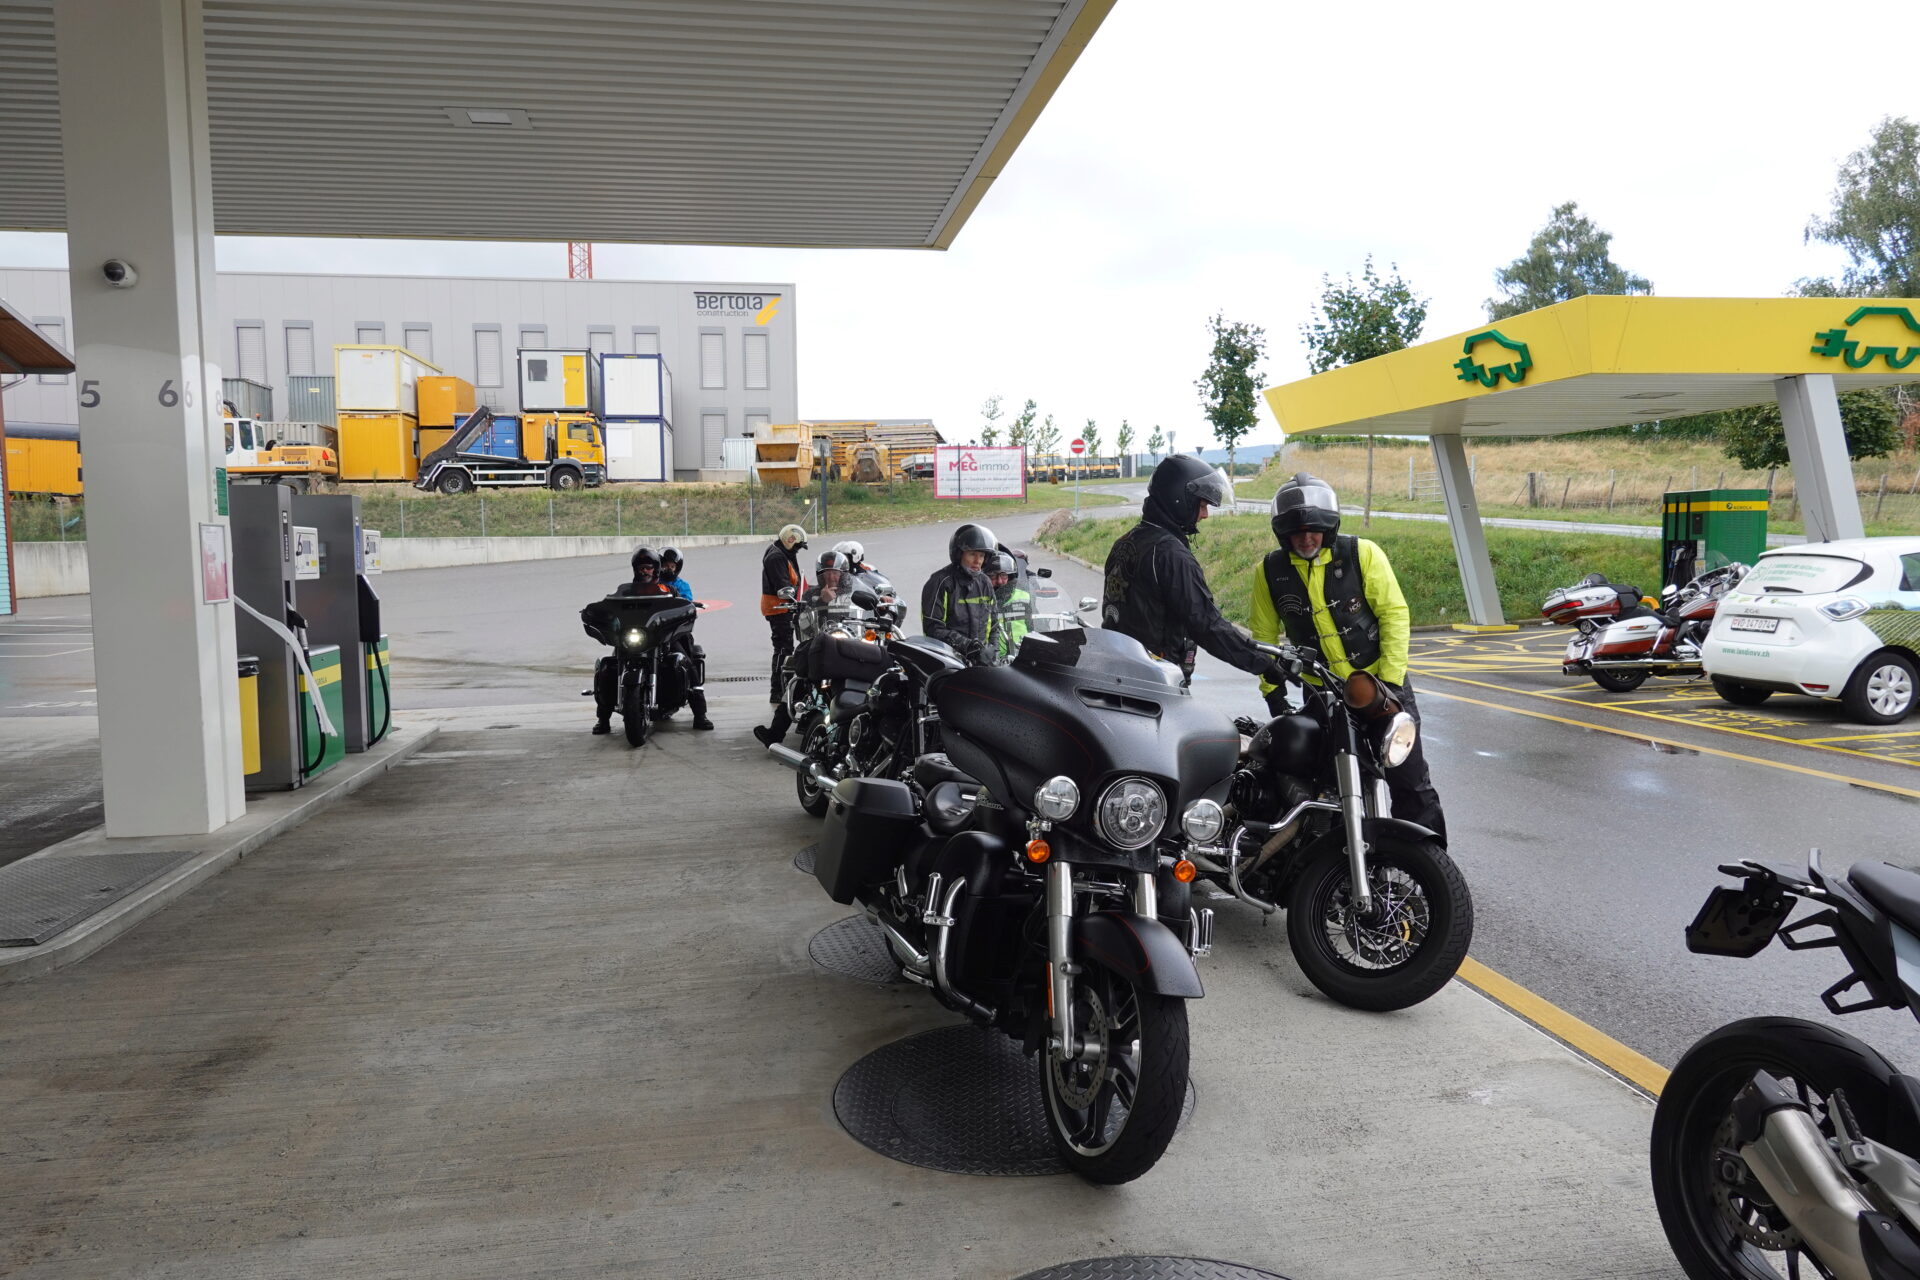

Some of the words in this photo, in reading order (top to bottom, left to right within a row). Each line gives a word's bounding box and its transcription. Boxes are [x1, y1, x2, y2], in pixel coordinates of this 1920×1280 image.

[80, 380, 100, 408] 5
[158, 379, 179, 408] 6
[184, 381, 193, 408] 6
[215, 390, 223, 416] 8
[949, 461, 978, 471] MEG
[980, 463, 1009, 471] immo
